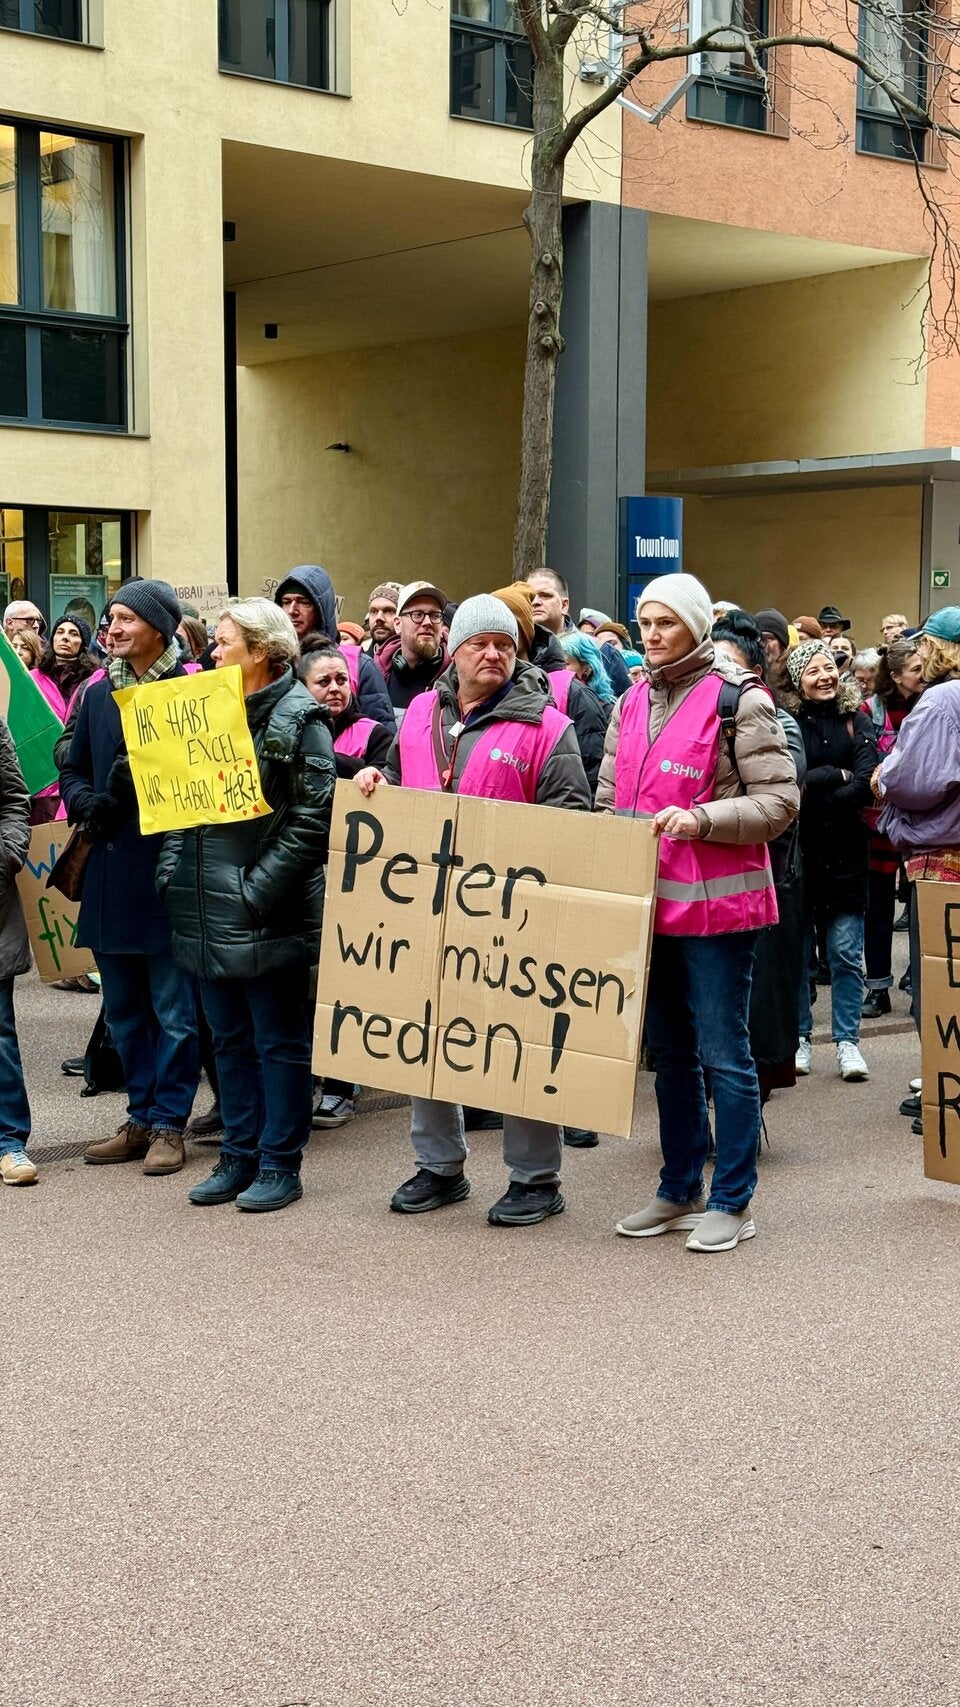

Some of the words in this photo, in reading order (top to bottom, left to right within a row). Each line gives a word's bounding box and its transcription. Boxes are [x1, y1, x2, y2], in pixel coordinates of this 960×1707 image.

[635, 535, 679, 558] TownTown
[133, 698, 160, 747] IHR
[166, 695, 211, 739] HABT
[187, 733, 243, 766] EXCEL
[502, 752, 530, 773] SHW
[671, 763, 705, 780] SHW
[140, 770, 166, 807] WIR
[170, 775, 217, 813] HABEN
[223, 769, 260, 812] HERZ
[341, 810, 547, 932] Peter,
[337, 921, 410, 974] wir
[442, 935, 625, 1015] müssen
